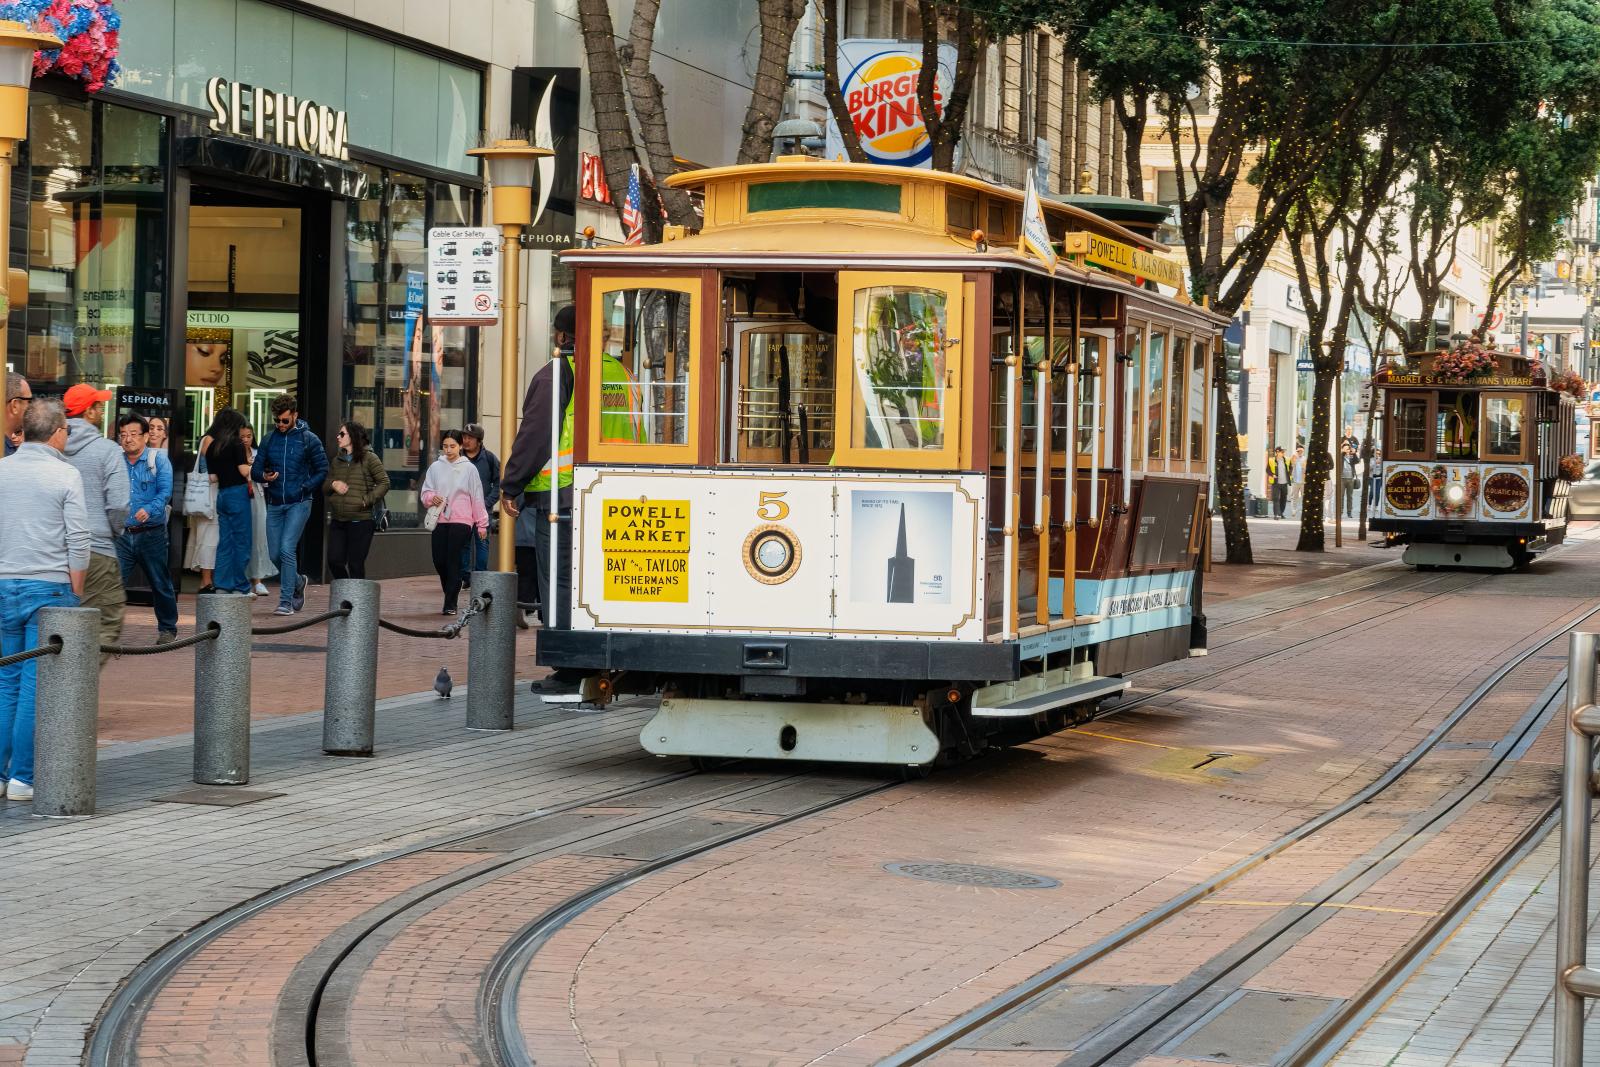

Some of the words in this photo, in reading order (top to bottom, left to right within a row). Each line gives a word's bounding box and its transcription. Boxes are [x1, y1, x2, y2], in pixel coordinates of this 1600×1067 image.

[206, 77, 349, 161] SEPHORA
[432, 230, 451, 238] Cable
[464, 230, 486, 239] Safety
[520, 233, 571, 244] EPHORA
[1089, 238, 1127, 266] POWELL
[1131, 252, 1138, 269] &
[1140, 254, 1169, 280] MASON
[188, 313, 230, 324] STUDIO
[1388, 375, 1421, 384] MARKET
[1502, 377, 1535, 386] WHARF
[121, 394, 169, 405] SEPHORA
[1452, 469, 1462, 482] 1
[757, 491, 790, 521] 5
[608, 505, 686, 519] POWELL
[628, 519, 666, 529] AND
[605, 529, 686, 542] MARKET
[607, 558, 627, 572] BAY
[645, 558, 686, 573] TAYLOR
[613, 575, 679, 585] FISHERMANS
[629, 586, 663, 596] WHARF
